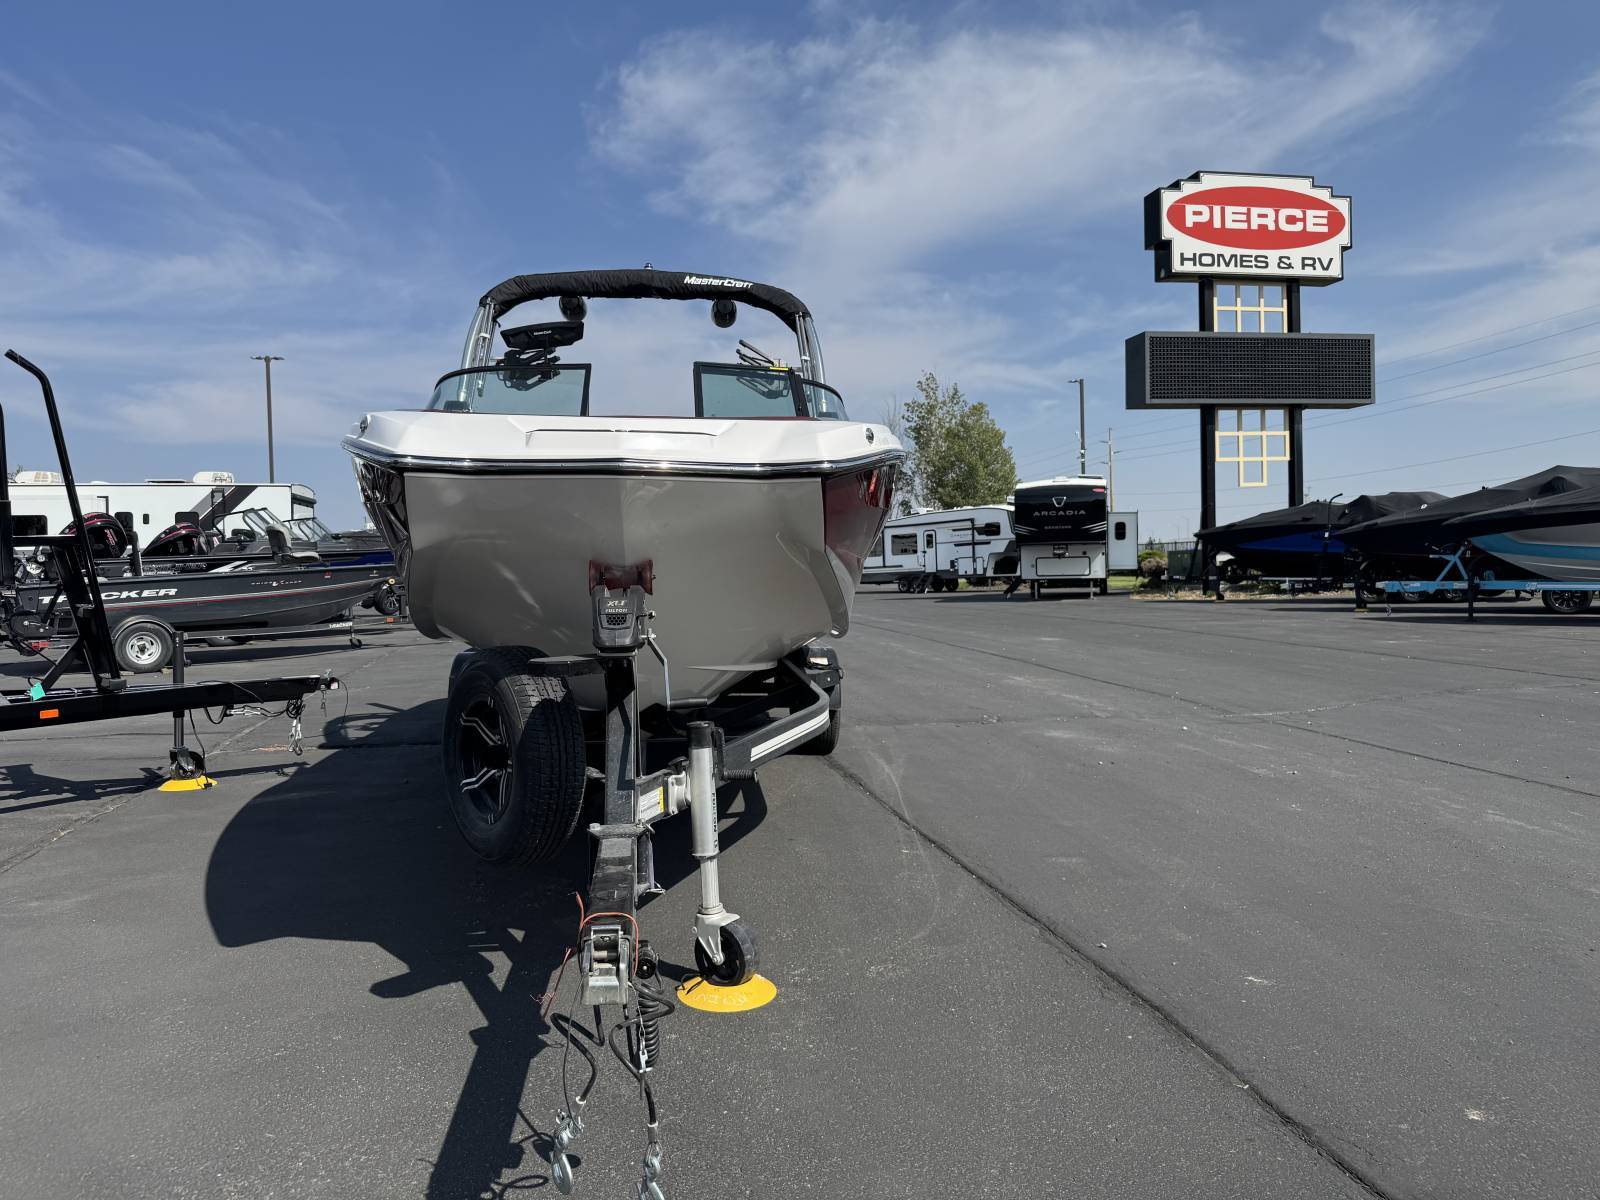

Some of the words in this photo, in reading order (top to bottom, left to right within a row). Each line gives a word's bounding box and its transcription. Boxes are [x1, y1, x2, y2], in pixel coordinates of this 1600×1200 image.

[1185, 204, 1328, 232] PIERCE
[1180, 252, 1269, 269] HOMES
[1277, 256, 1294, 270] &
[1301, 257, 1334, 272] RV
[684, 275, 754, 288] MasterCraft
